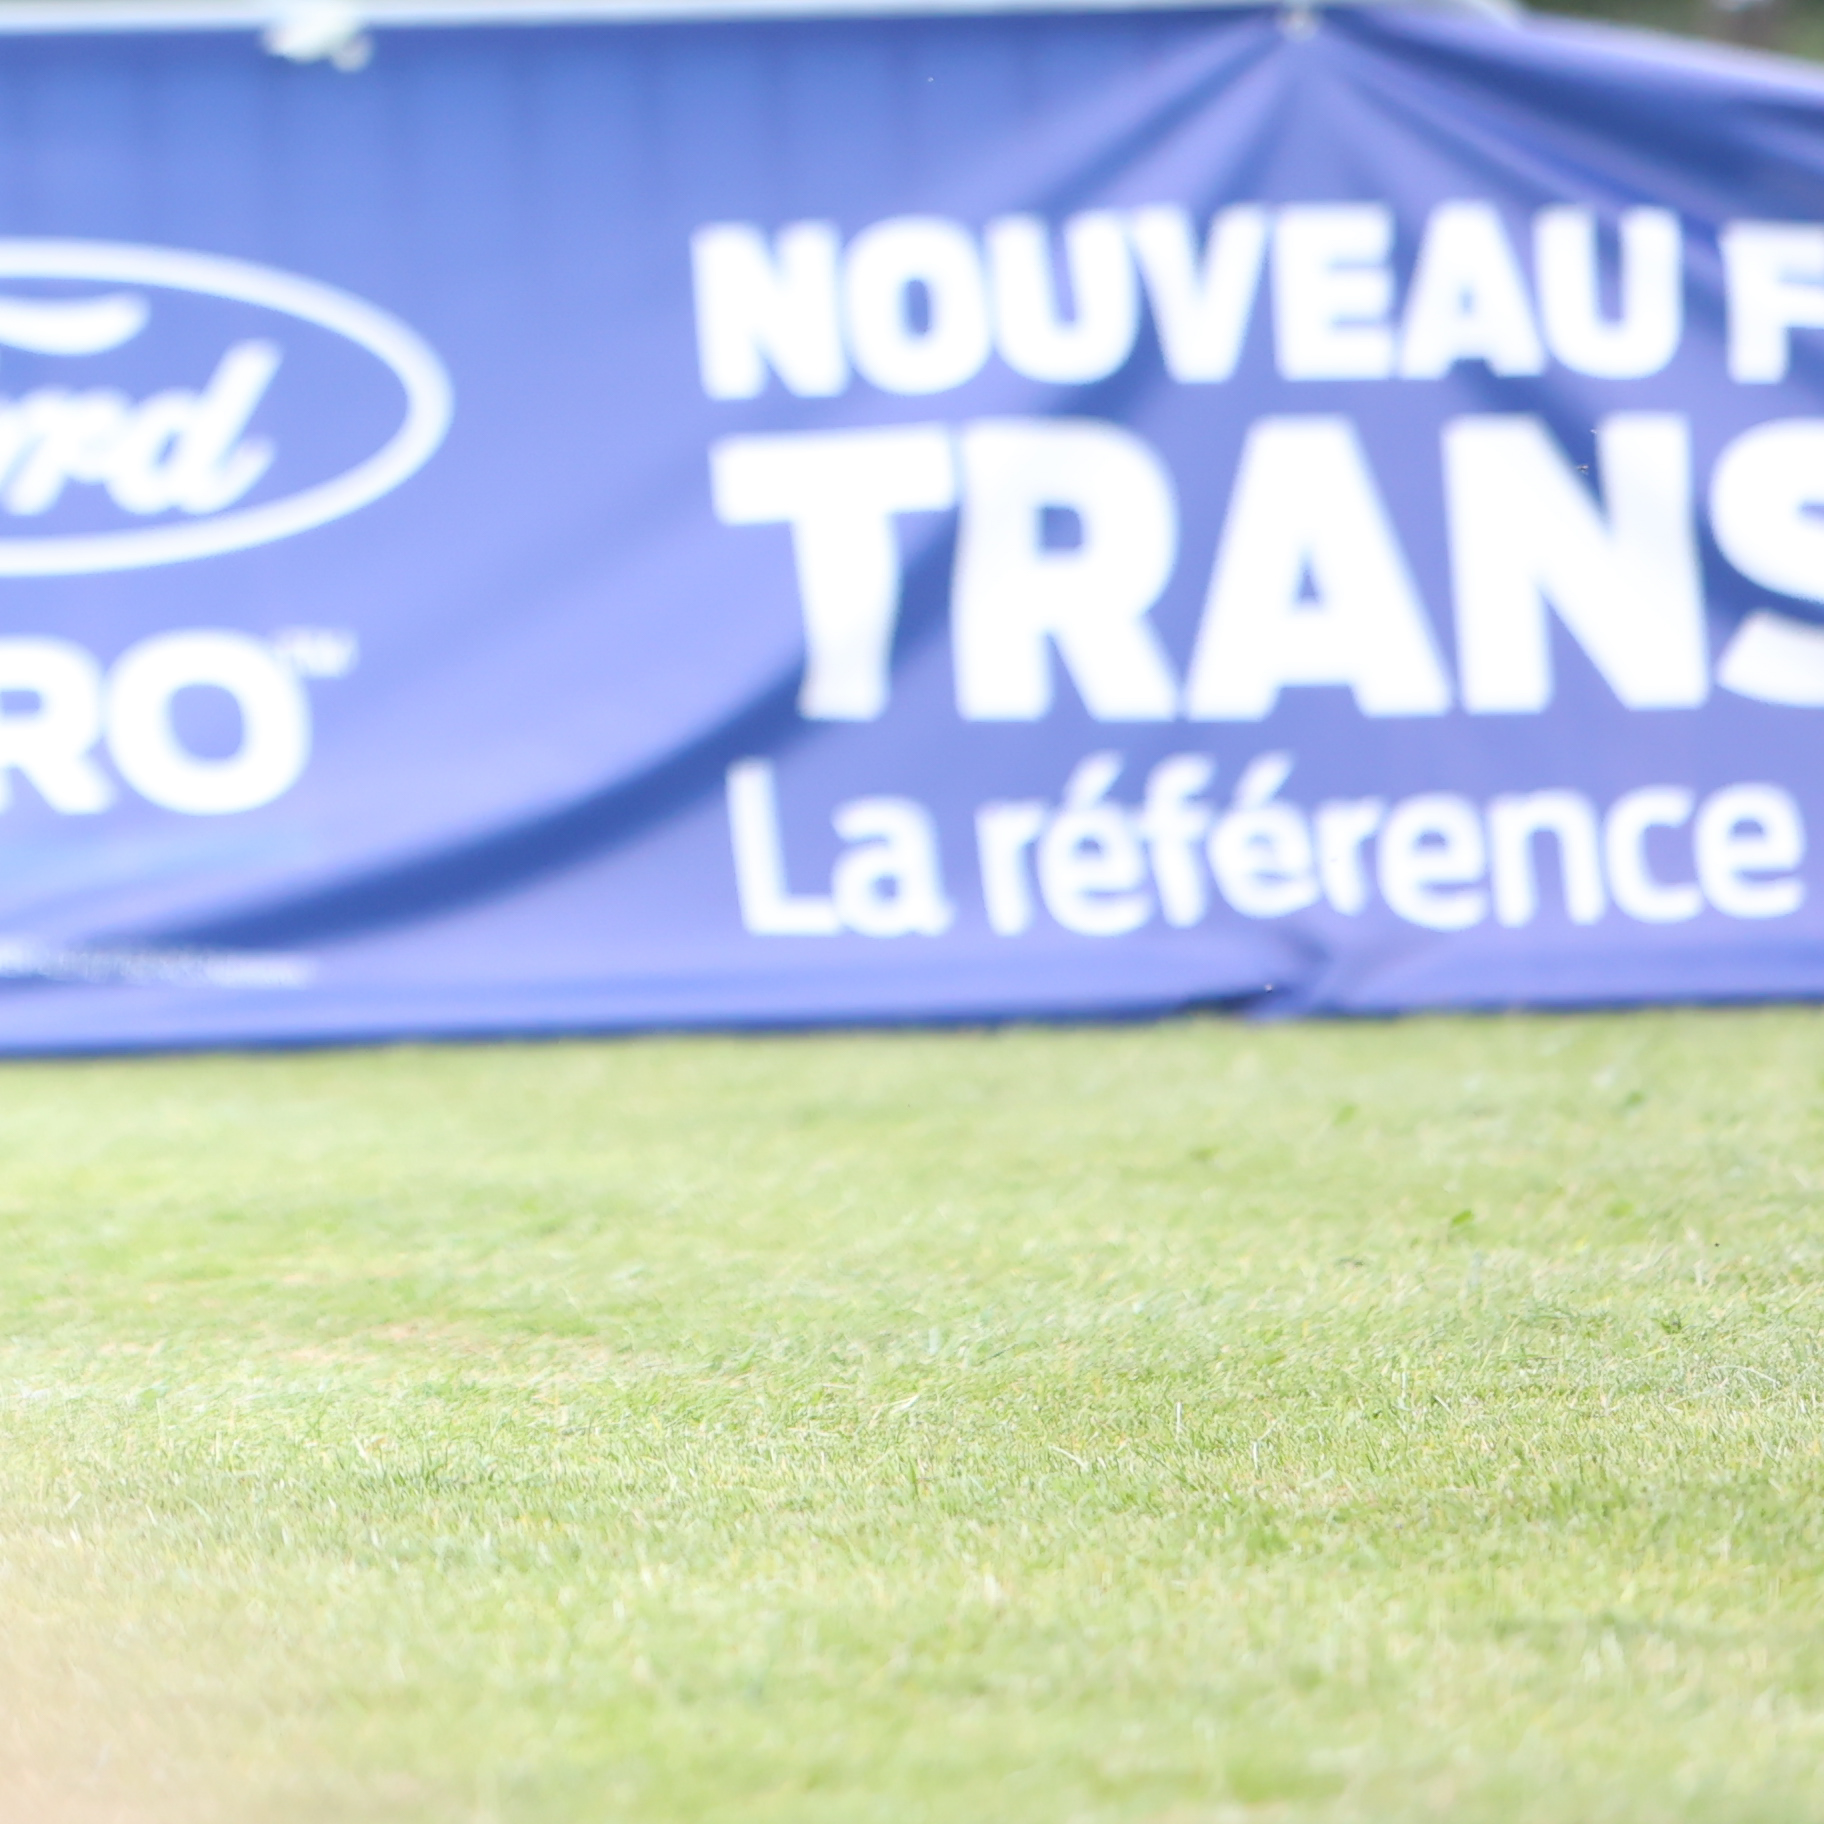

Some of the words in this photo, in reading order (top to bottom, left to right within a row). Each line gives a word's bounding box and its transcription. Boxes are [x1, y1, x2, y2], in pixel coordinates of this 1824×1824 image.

[690, 199, 1683, 399] NOUVEAU
[725, 759, 954, 937] La
[975, 752, 1805, 937] référence
